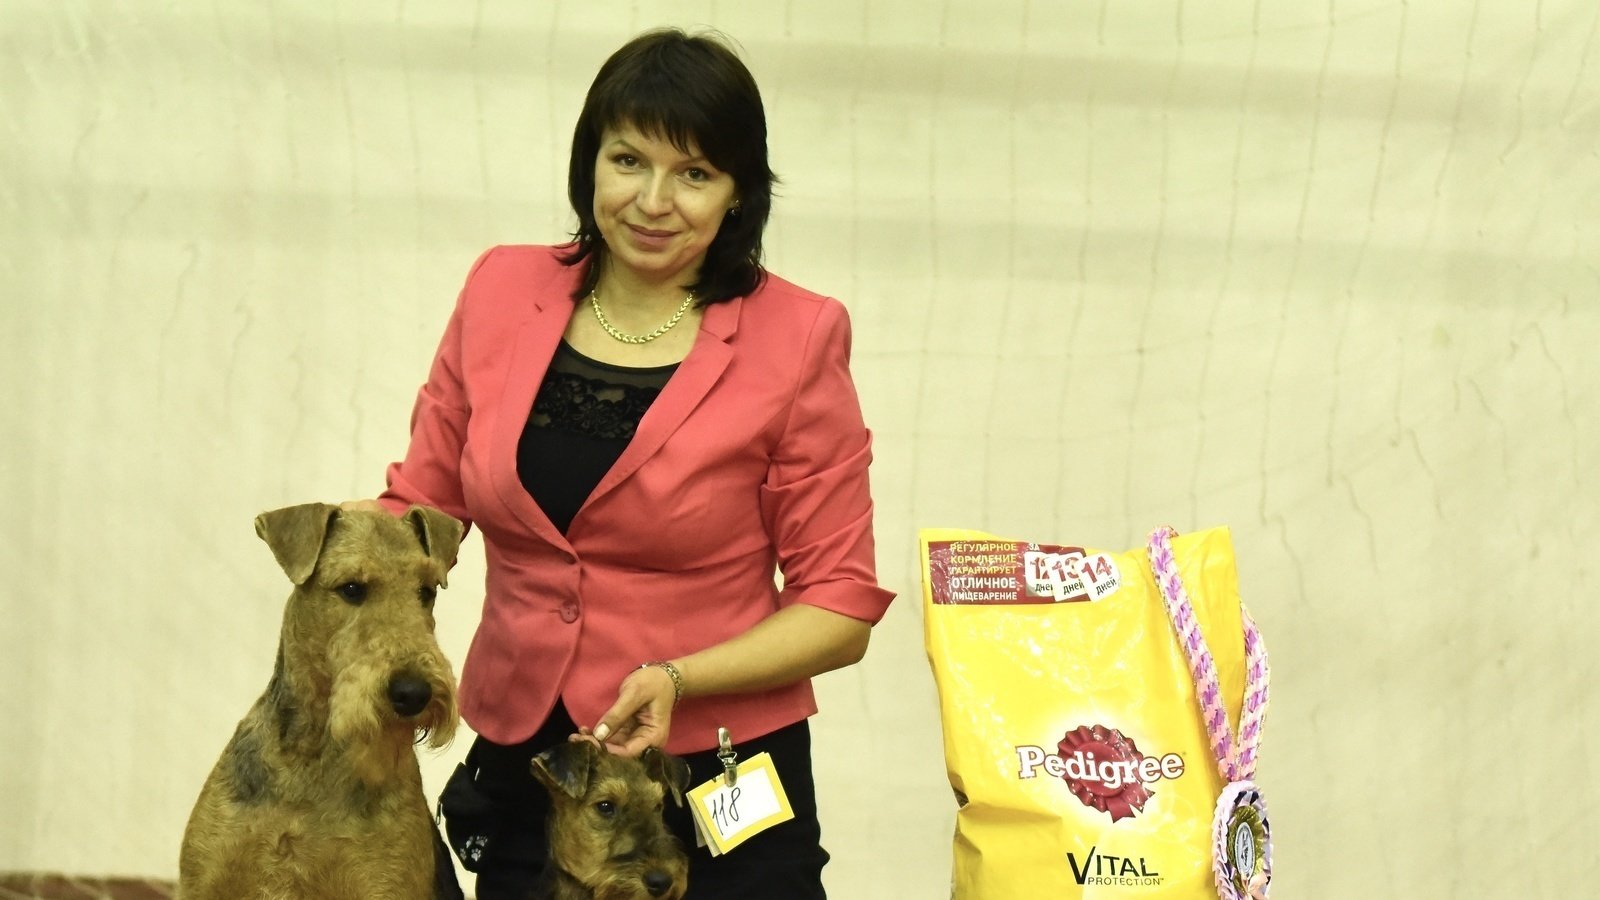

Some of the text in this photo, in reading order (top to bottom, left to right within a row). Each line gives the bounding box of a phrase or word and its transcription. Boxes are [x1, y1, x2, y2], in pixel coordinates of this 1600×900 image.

[950, 543, 1017, 553] РЕГУЛЯРНОЕ
[1028, 543, 1040, 551] ЗА
[950, 554, 1017, 564] КОРМЛЕНИЕ
[950, 566, 1017, 575] ГАРАНТИРУЕТ
[1052, 557, 1080, 582] 13
[1081, 556, 1113, 583] 14
[951, 577, 1017, 588] ОТЛИЧНОЕ
[1095, 577, 1117, 595] дней
[952, 592, 1017, 602] ПИЩЕВАРЕНИЕ
[1015, 745, 1185, 789] Pedigree
[712, 786, 741, 836] 118
[1066, 846, 1159, 886] VITAL
